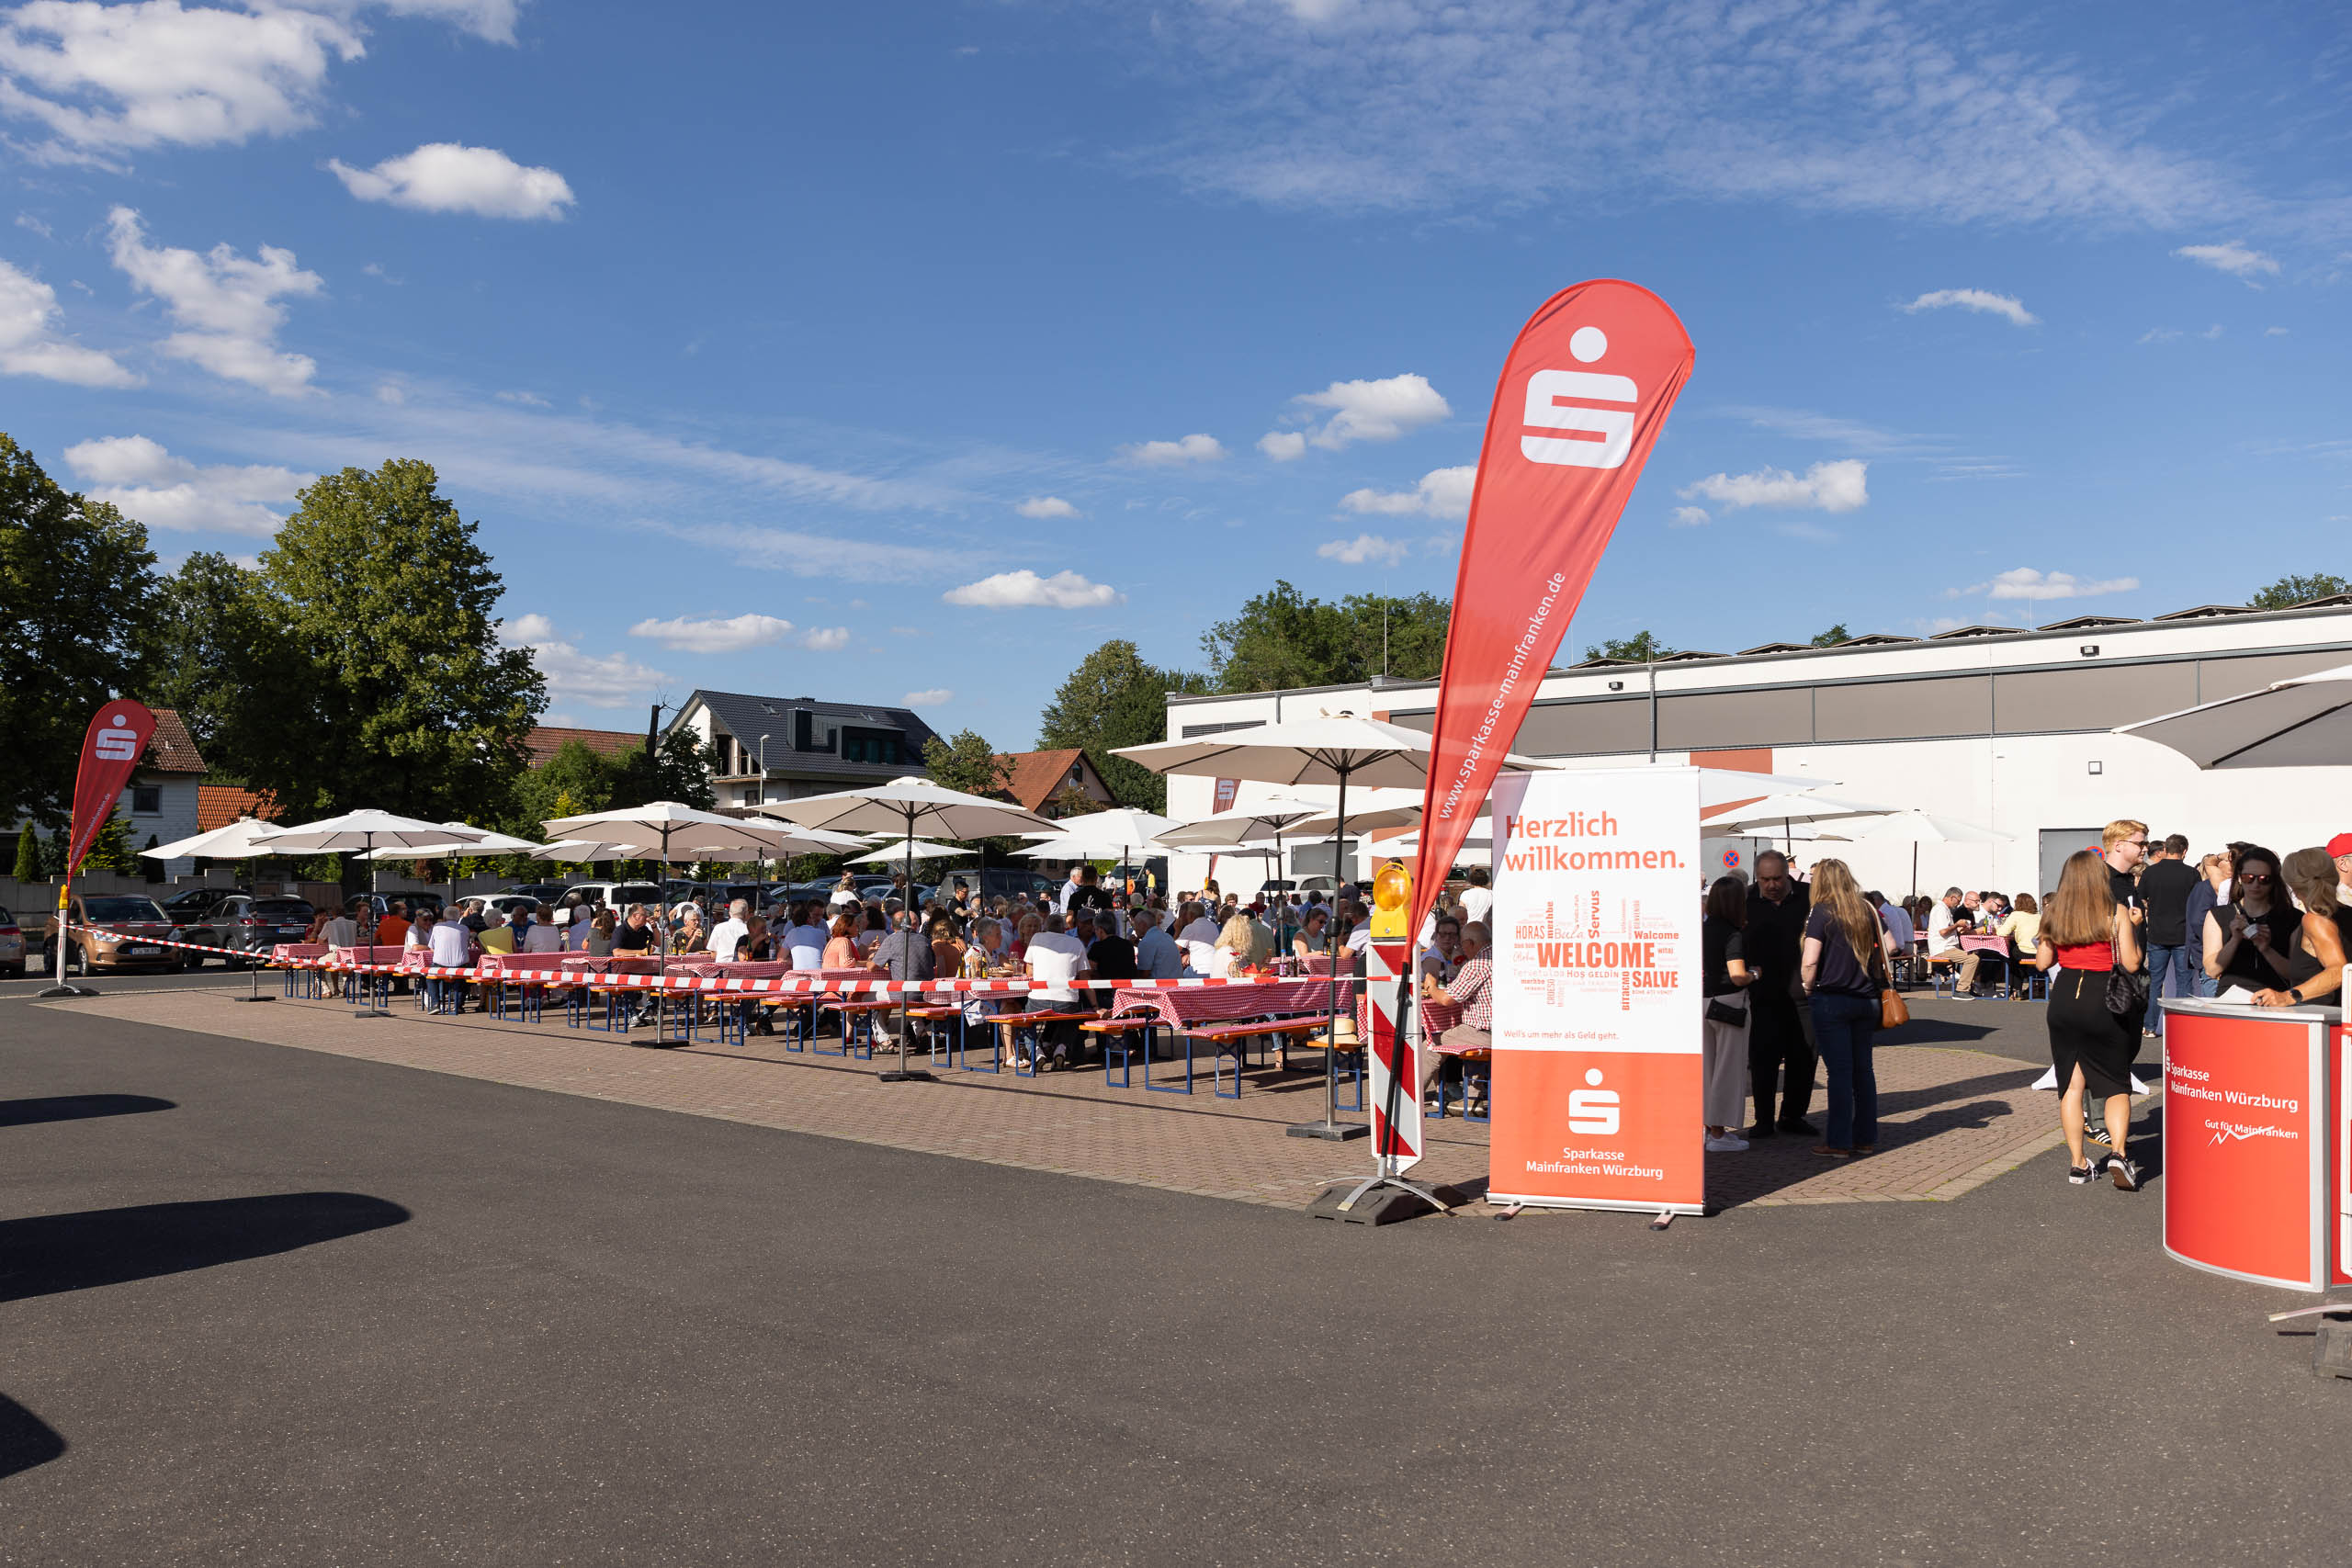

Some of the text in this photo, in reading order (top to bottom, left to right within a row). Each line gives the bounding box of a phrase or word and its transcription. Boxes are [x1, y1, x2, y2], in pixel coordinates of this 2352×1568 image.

[1439, 571, 1566, 819] www.sparkasse-mainfranken.de
[1506, 810, 1618, 839] Herzlich
[1504, 845, 1685, 871] willkommen.
[1588, 889, 1600, 940] Servus
[1515, 925, 1545, 940] HORAS
[1537, 942, 1656, 968] WELCOME
[1632, 970, 1679, 988] SALVE
[1541, 1030, 1562, 1039] mehr
[1564, 1030, 1576, 1039] als
[1577, 1031, 1596, 1040] Geld
[2170, 1062, 2210, 1082] Sparkasse
[2170, 1080, 2299, 1112] Mainfranken Würzburg
[2204, 1119, 2299, 1139] Gut für Mainfranken
[1563, 1147, 1625, 1161] Sparkasse
[1526, 1160, 1664, 1180] Mainfranken Würzburg
